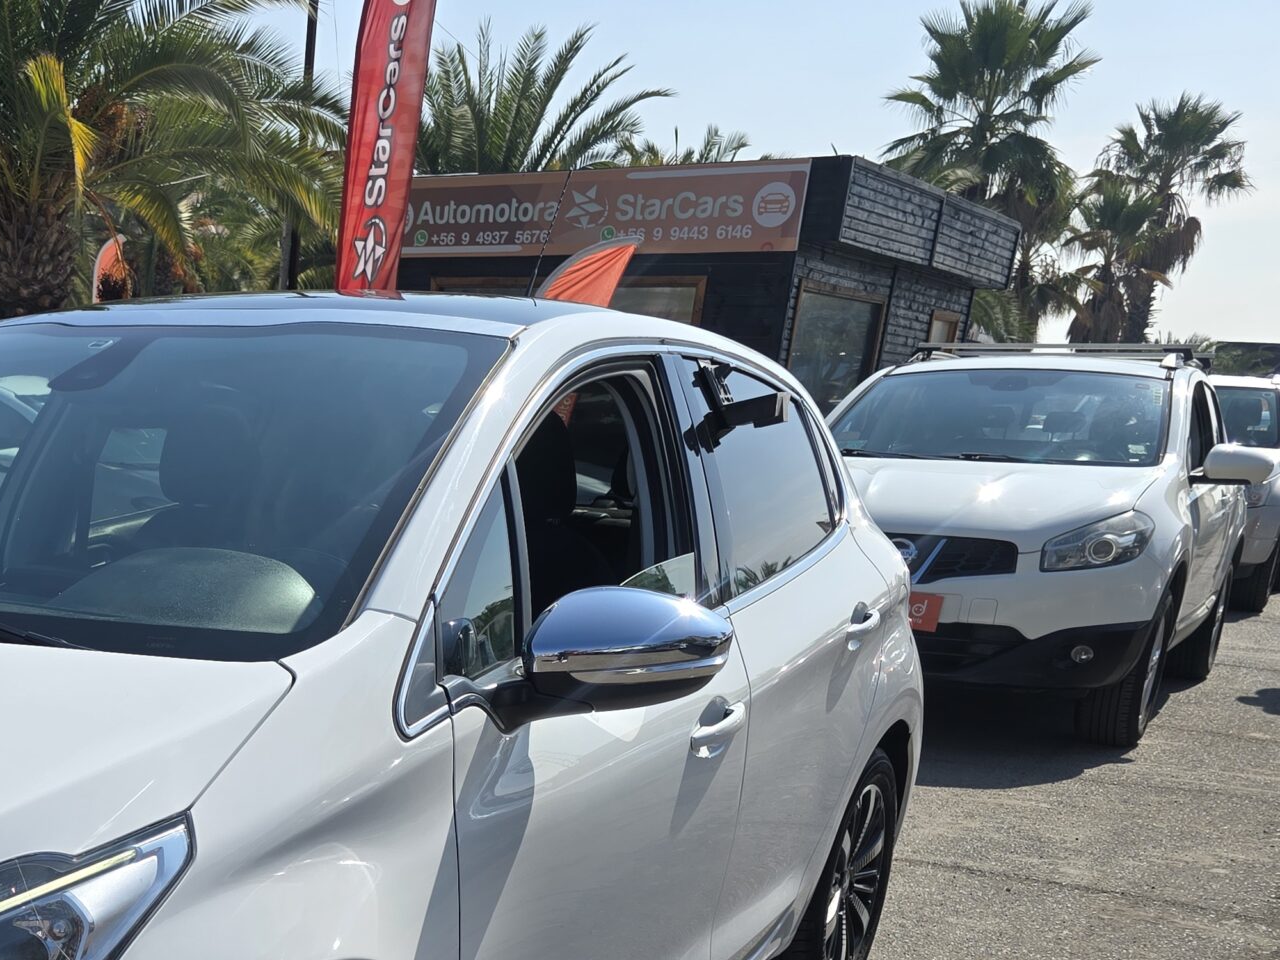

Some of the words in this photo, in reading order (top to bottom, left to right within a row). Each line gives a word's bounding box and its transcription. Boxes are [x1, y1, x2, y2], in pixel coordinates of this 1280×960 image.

[364, 14, 407, 208] StarCars
[416, 198, 557, 225] Automotora
[615, 191, 744, 221] StarCars
[431, 232, 455, 245] +56
[461, 232, 470, 245] 9
[476, 231, 507, 244] 4937
[514, 230, 548, 243] 5676
[653, 227, 663, 240] 9
[670, 226, 708, 240] 9443
[716, 225, 752, 239] 6146
